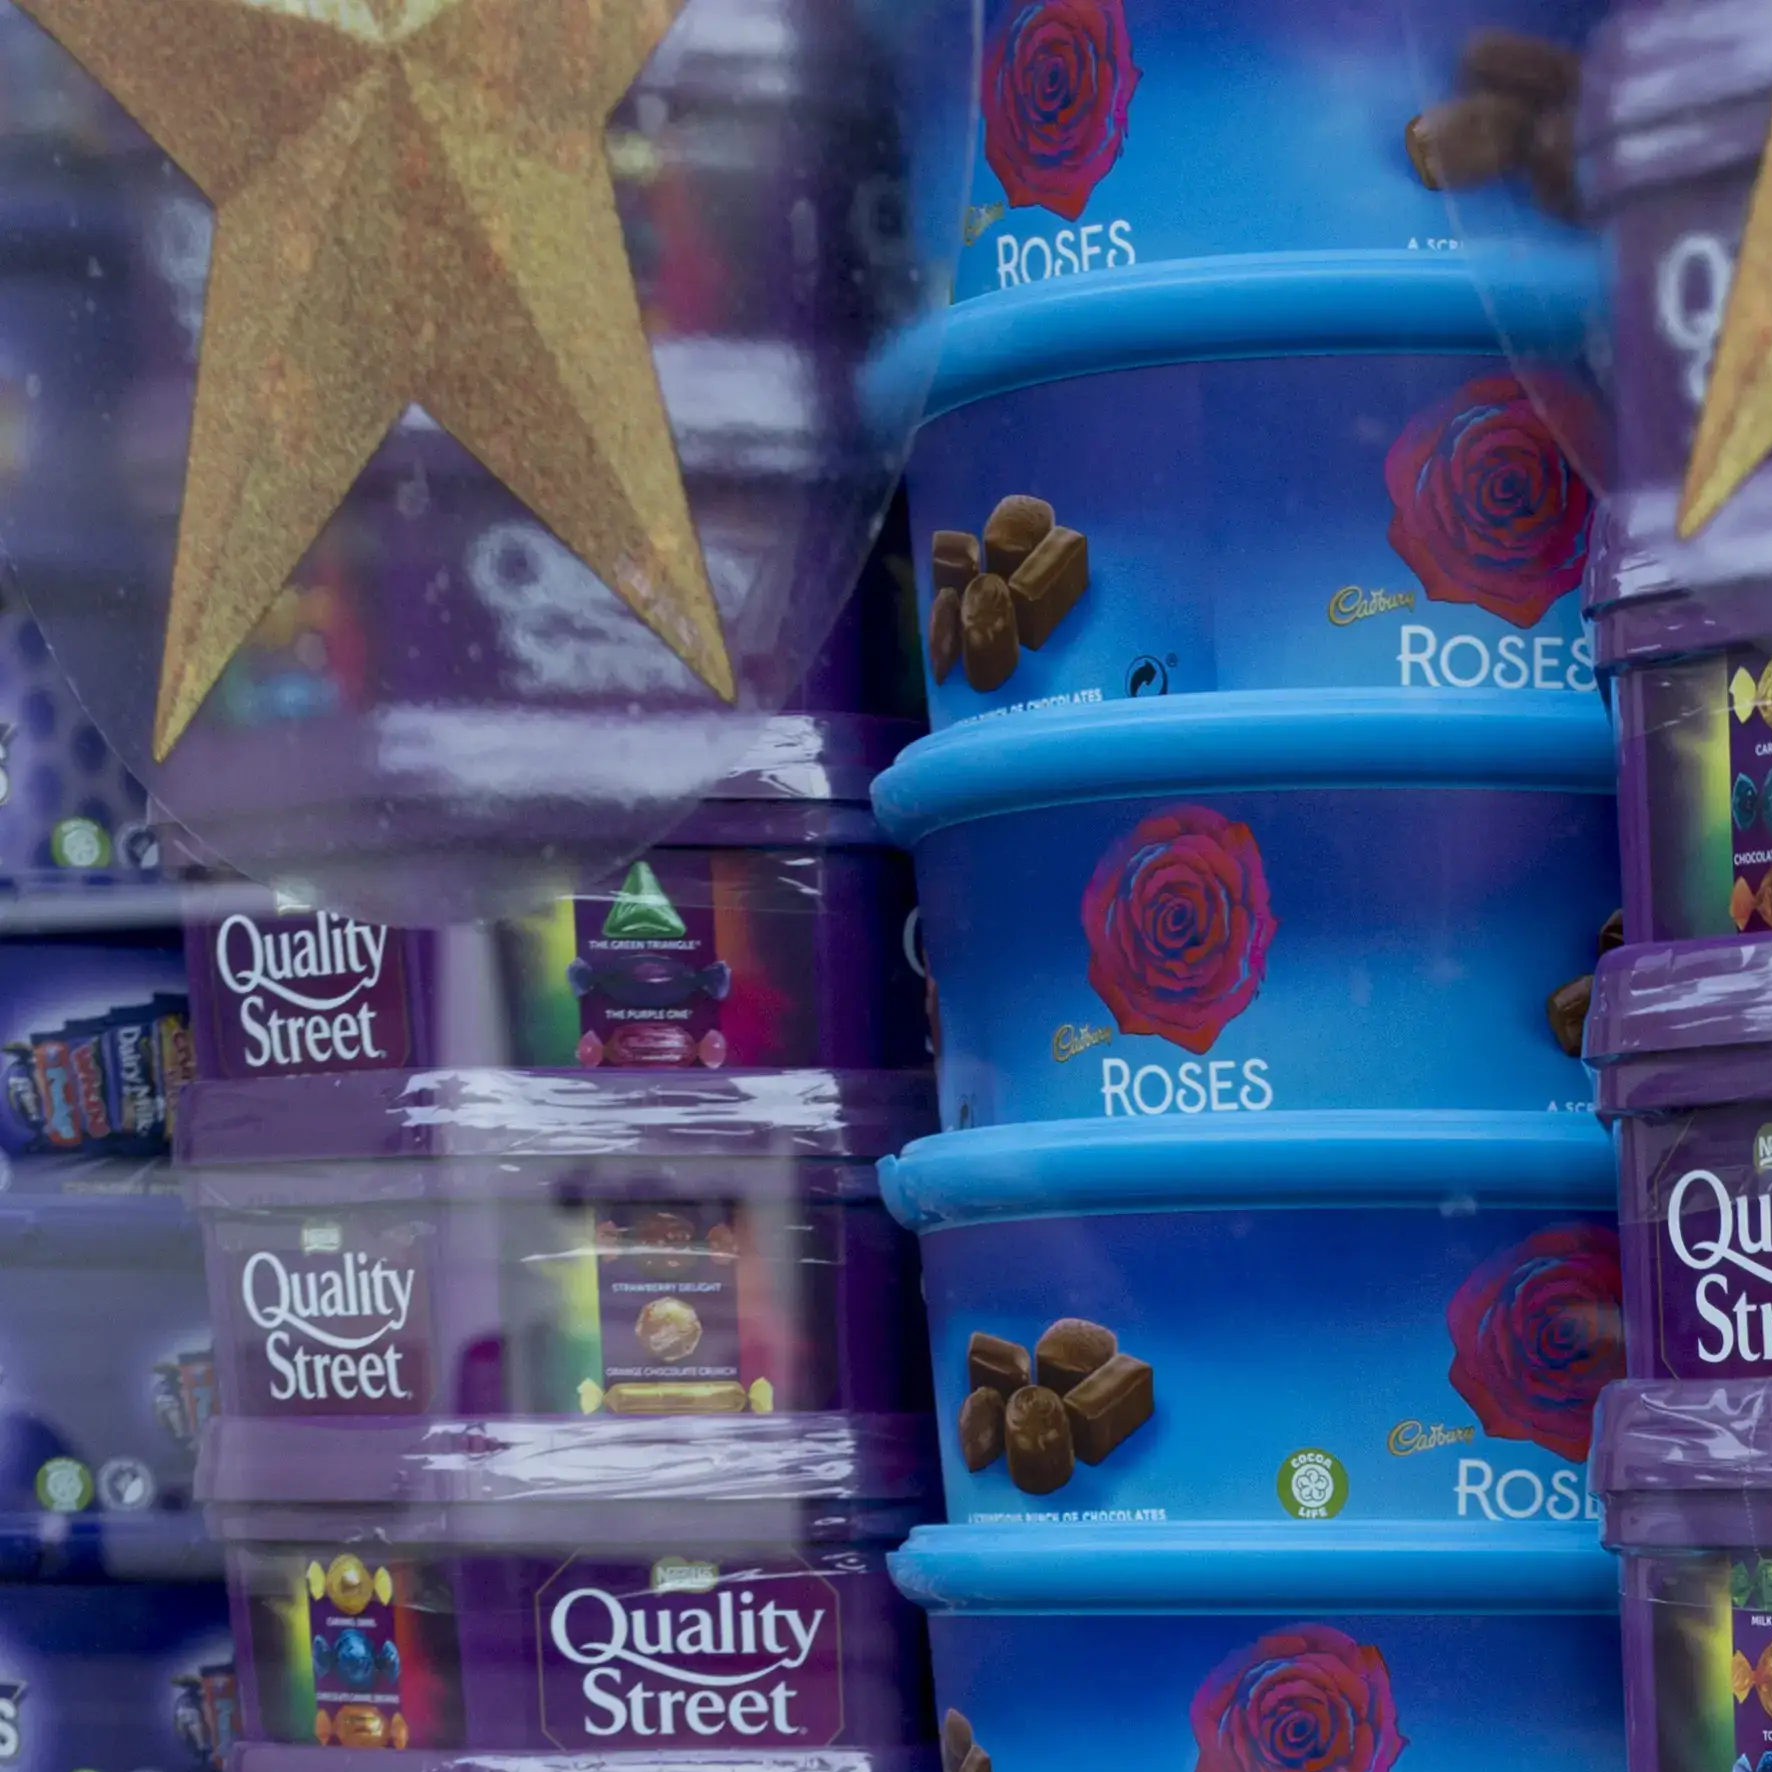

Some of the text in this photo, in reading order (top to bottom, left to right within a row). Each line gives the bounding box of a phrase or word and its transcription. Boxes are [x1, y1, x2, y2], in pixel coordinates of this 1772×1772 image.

[997, 219, 1136, 289] ROSES
[1328, 585, 1416, 626] Cadbury
[1397, 625, 1597, 691] ROSES
[217, 911, 387, 1010] Quality
[240, 996, 378, 1067] Street
[1053, 1024, 1112, 1063] Cadbury
[1101, 1056, 1274, 1117] ROSES
[242, 1251, 415, 1349] Quality
[266, 1330, 408, 1400] Street
[1387, 1419, 1475, 1456] Cadbury
[550, 1587, 825, 1686] Quality
[1751, 1614, 1772, 1628] MILK
[583, 1670, 803, 1737] Street
